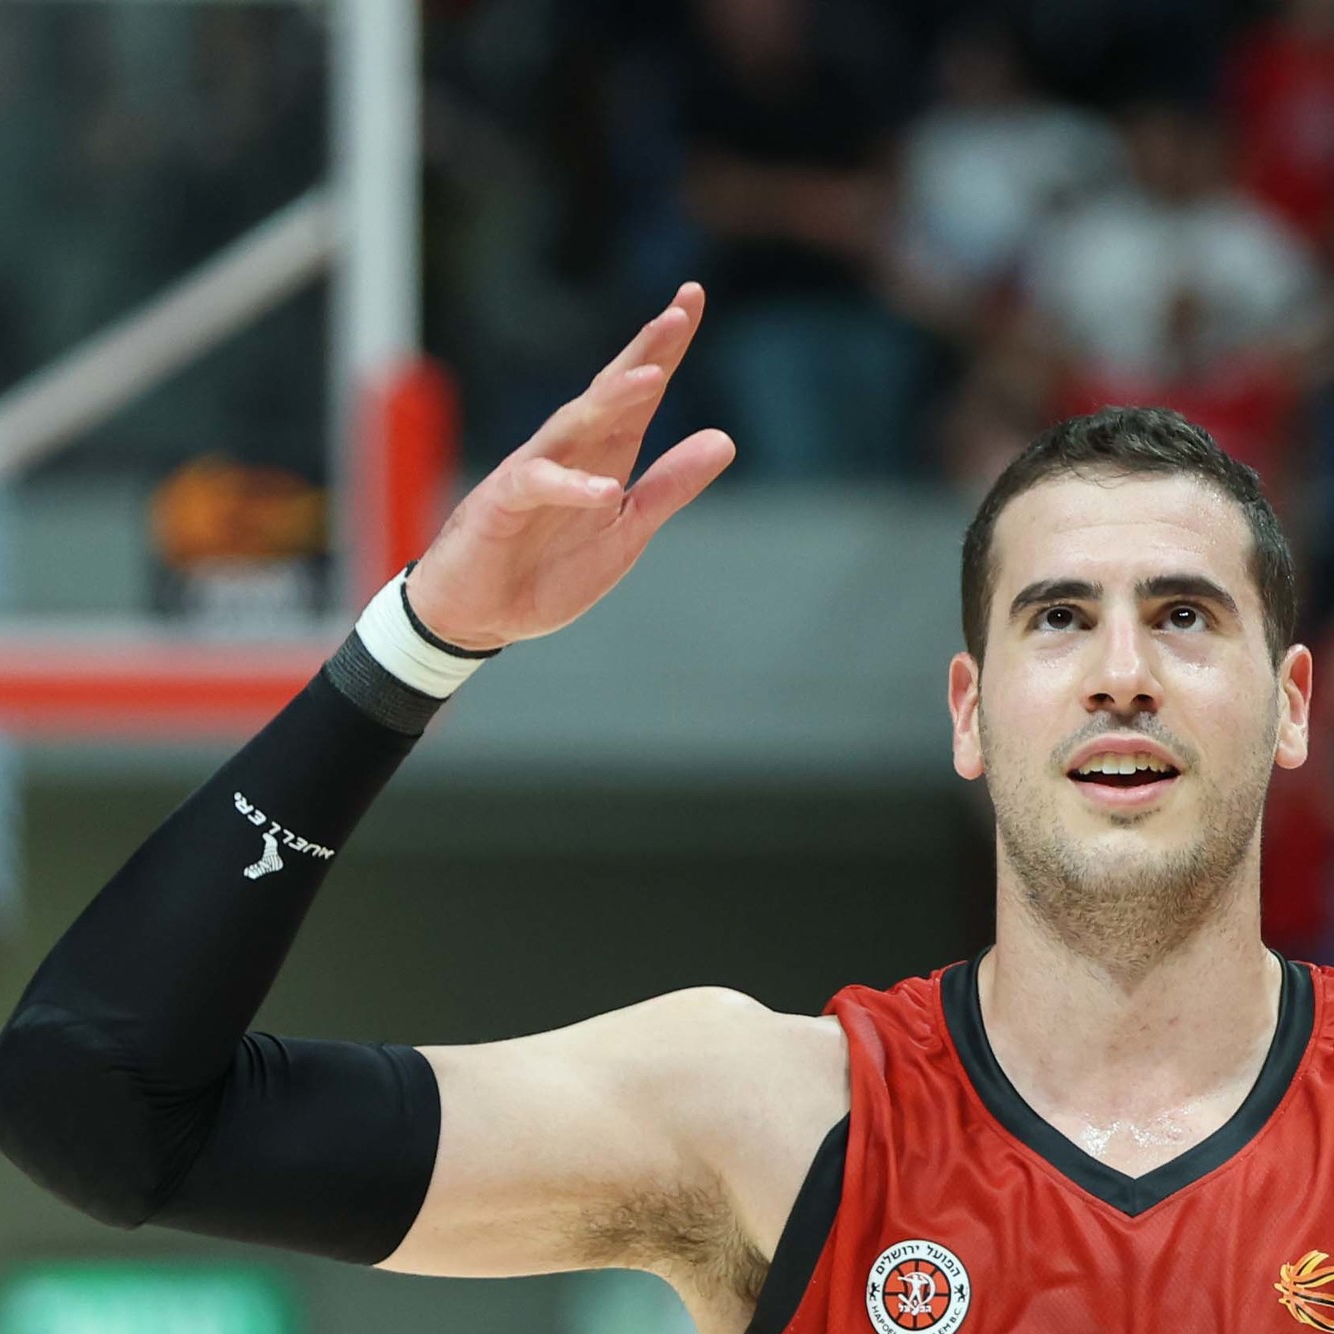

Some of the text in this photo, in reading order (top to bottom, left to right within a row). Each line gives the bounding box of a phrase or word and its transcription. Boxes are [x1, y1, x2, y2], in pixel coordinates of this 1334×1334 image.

[235, 796, 335, 860] MUELLER
[875, 1244, 961, 1278] הפועל ירושלים
